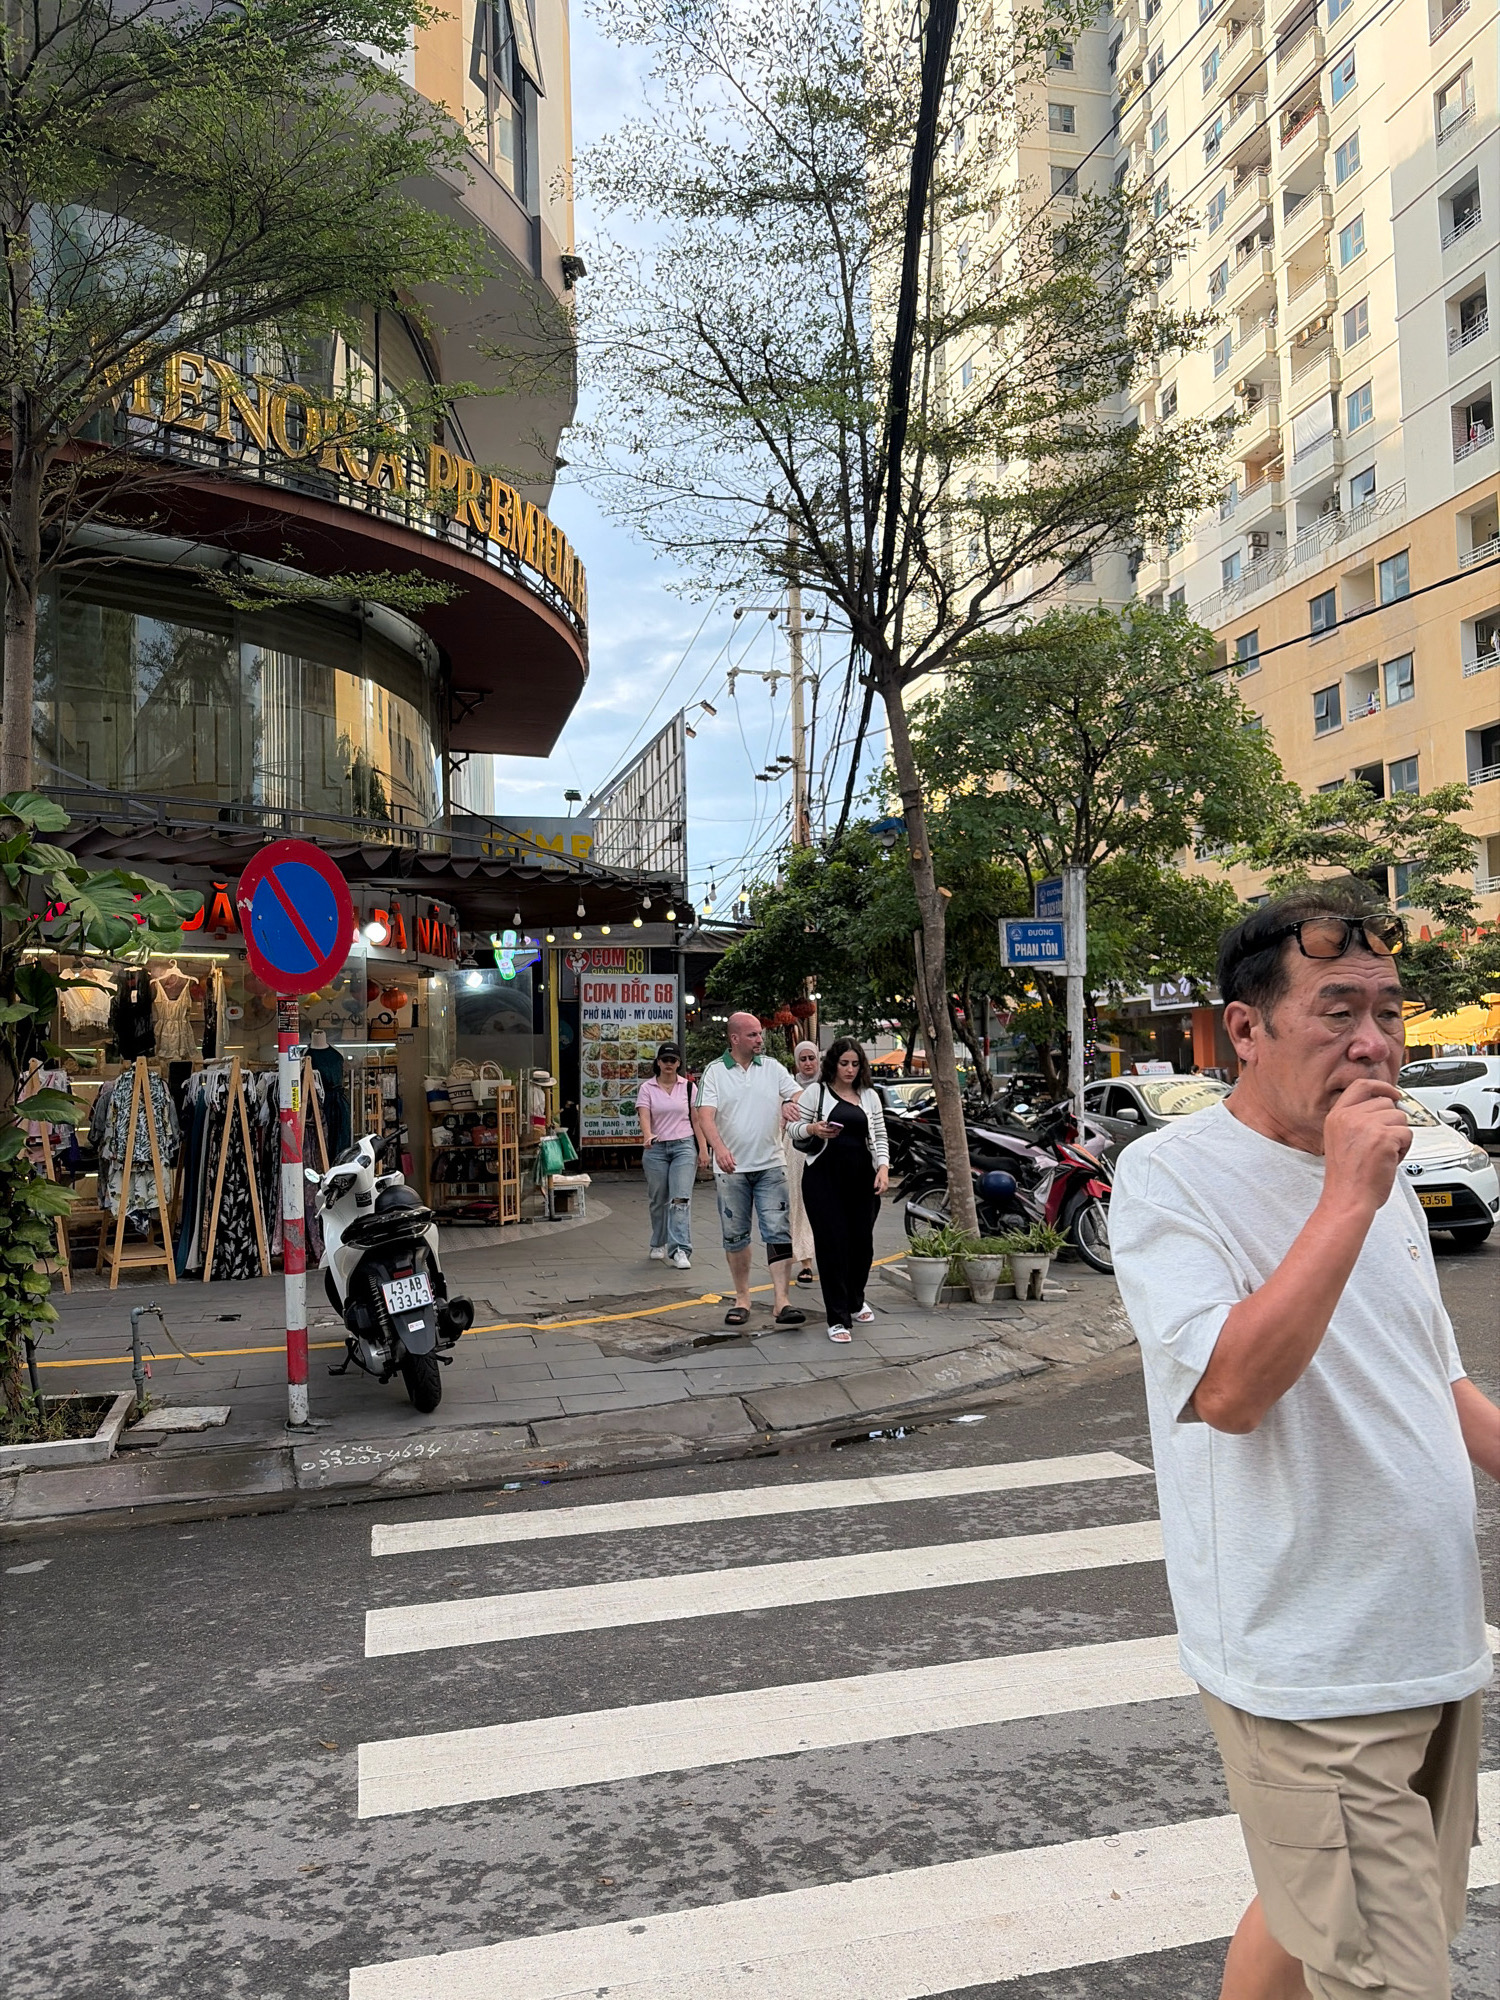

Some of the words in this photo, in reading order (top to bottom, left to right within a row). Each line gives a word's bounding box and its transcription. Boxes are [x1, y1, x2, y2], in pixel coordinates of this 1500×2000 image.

[1014, 943, 1039, 956] PHAN
[627, 948, 644, 974] 68
[583, 982, 617, 1003] CƠM
[621, 977, 650, 1003] BẮC
[654, 983, 673, 1003] 68
[601, 1007, 611, 1019] HÀ
[613, 1007, 627, 1021] NỘI
[647, 1006, 673, 1020] QUẢNG
[390, 1276, 423, 1296] 43-AB
[389, 1289, 430, 1311] 133.43
